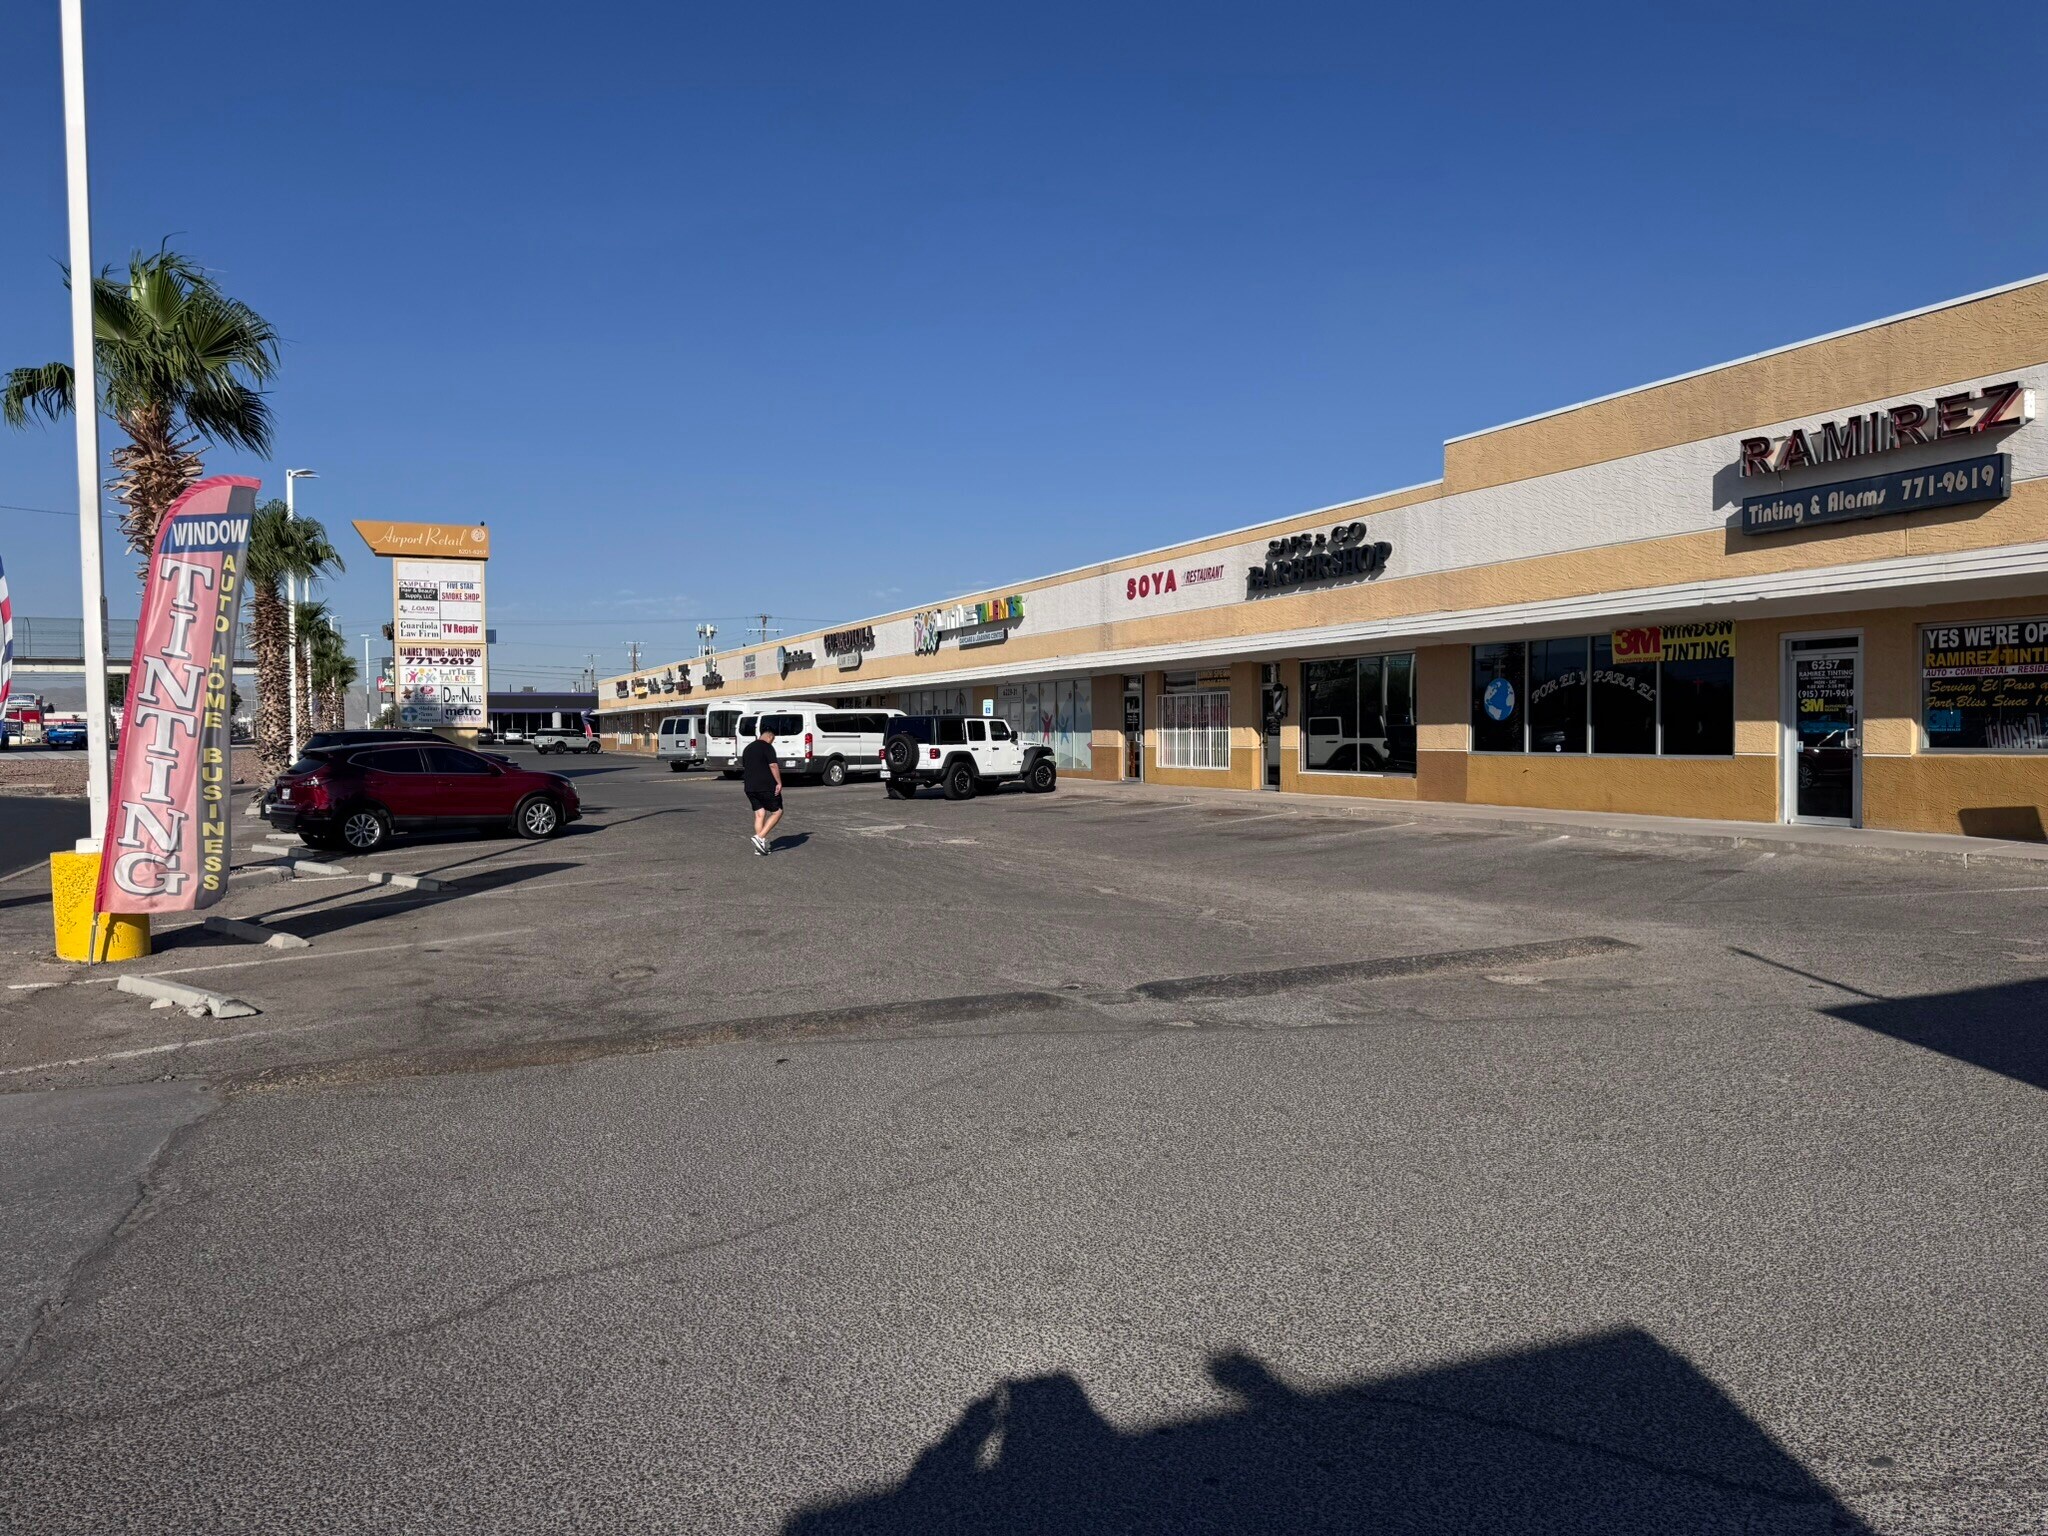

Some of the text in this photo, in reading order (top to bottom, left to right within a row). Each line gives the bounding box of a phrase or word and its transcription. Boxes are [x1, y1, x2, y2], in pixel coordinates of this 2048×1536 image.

[1740, 381, 2036, 477] RAMIREZ
[1748, 465, 1995, 524] Tinting & Alarms 771-9619
[172, 518, 249, 547] WINDOW
[371, 525, 467, 548] Airport Retail
[1247, 541, 1393, 590] BARBERSHOP
[446, 582, 474, 590] FIVE STAR
[1126, 564, 1224, 600] SOYA RESTAURANT
[442, 592, 463, 600] SMOKE
[400, 620, 438, 630] Guardiola
[400, 629, 439, 638] Law Firm
[442, 623, 479, 635] TV Repair
[823, 625, 875, 652] GUARDIOLA
[1614, 620, 1734, 656] 3M WINDOW
[1926, 628, 1959, 649] YES
[1964, 624, 2019, 647] WE'RE
[399, 647, 422, 657] RAMIREZ
[1661, 640, 1730, 661] TINTING
[1925, 649, 1999, 668] RAMIREZ
[405, 657, 475, 665] 771-9619
[1811, 660, 1840, 670] 6257
[440, 668, 476, 676] LITTLE
[1925, 668, 1949, 677] AUTO
[1954, 666, 2009, 676] COMMERCIAL
[1531, 679, 1559, 704] POR
[1559, 671, 1576, 688] EL
[1593, 670, 1636, 691] PARA
[1636, 682, 1657, 702] EL
[1797, 688, 1855, 699] (915) 771-9619
[1930, 680, 1976, 695] Serving
[1981, 679, 1998, 692] El
[2002, 678, 2036, 691] Paso
[1800, 698, 1825, 713] 3M
[1925, 697, 1953, 710] Fort
[1956, 695, 1988, 708] Bliss
[1991, 694, 2029, 708] Since
[445, 707, 482, 716] metro
[112, 557, 214, 898] TINTING
[202, 553, 235, 891] AUTO HOME BUSINESS
